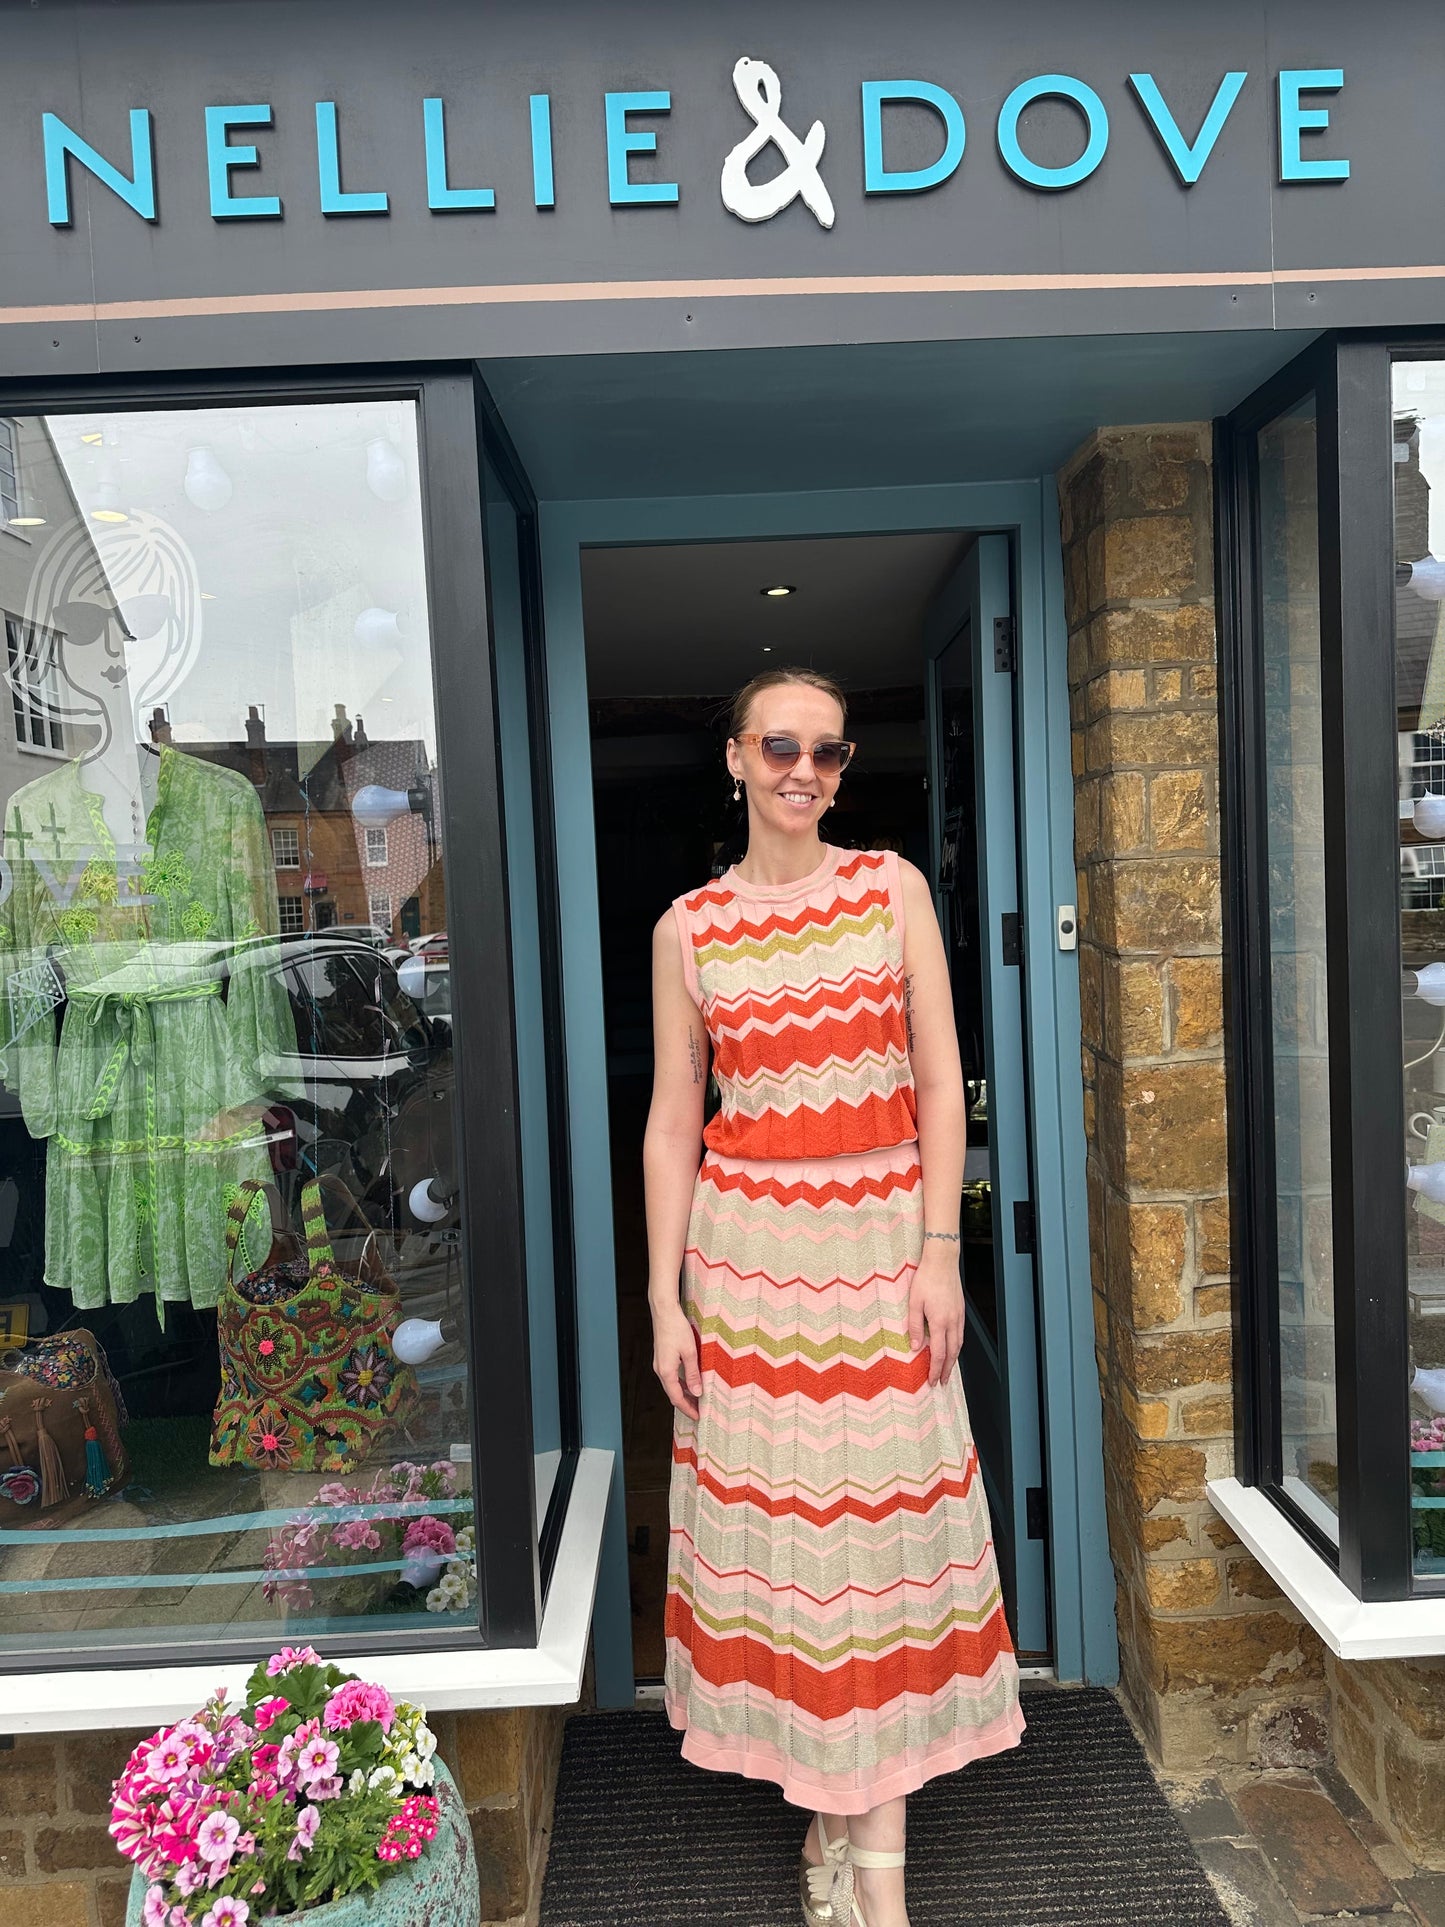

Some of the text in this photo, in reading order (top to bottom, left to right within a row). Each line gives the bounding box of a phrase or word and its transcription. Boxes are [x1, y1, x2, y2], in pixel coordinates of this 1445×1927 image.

[43, 57, 1350, 229] NELLIE & DOVE
